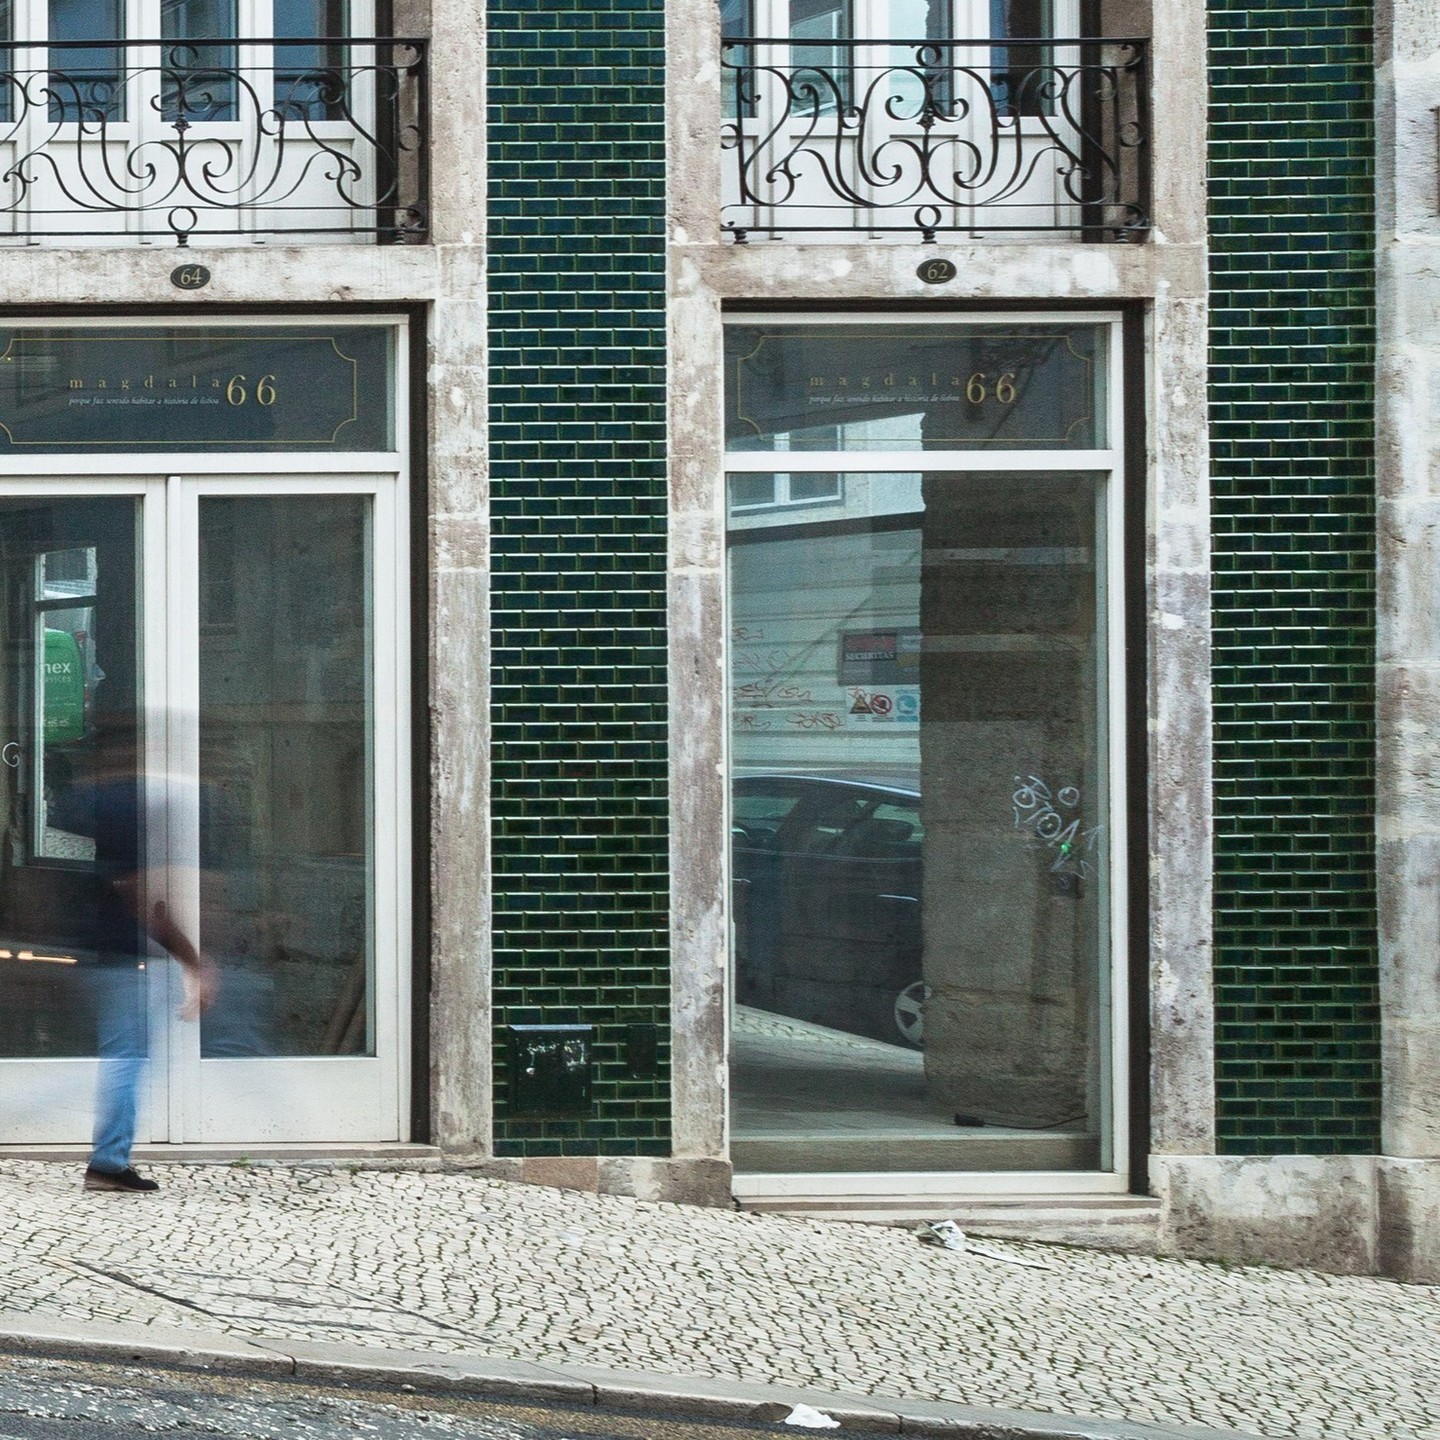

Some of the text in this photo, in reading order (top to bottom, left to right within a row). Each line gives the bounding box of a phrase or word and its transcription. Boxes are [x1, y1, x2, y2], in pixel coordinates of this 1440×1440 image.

[180, 267, 203, 285] 64
[927, 262, 948, 280] 62
[70, 374, 276, 406] magdala 66
[810, 372, 1015, 404] magdala 66
